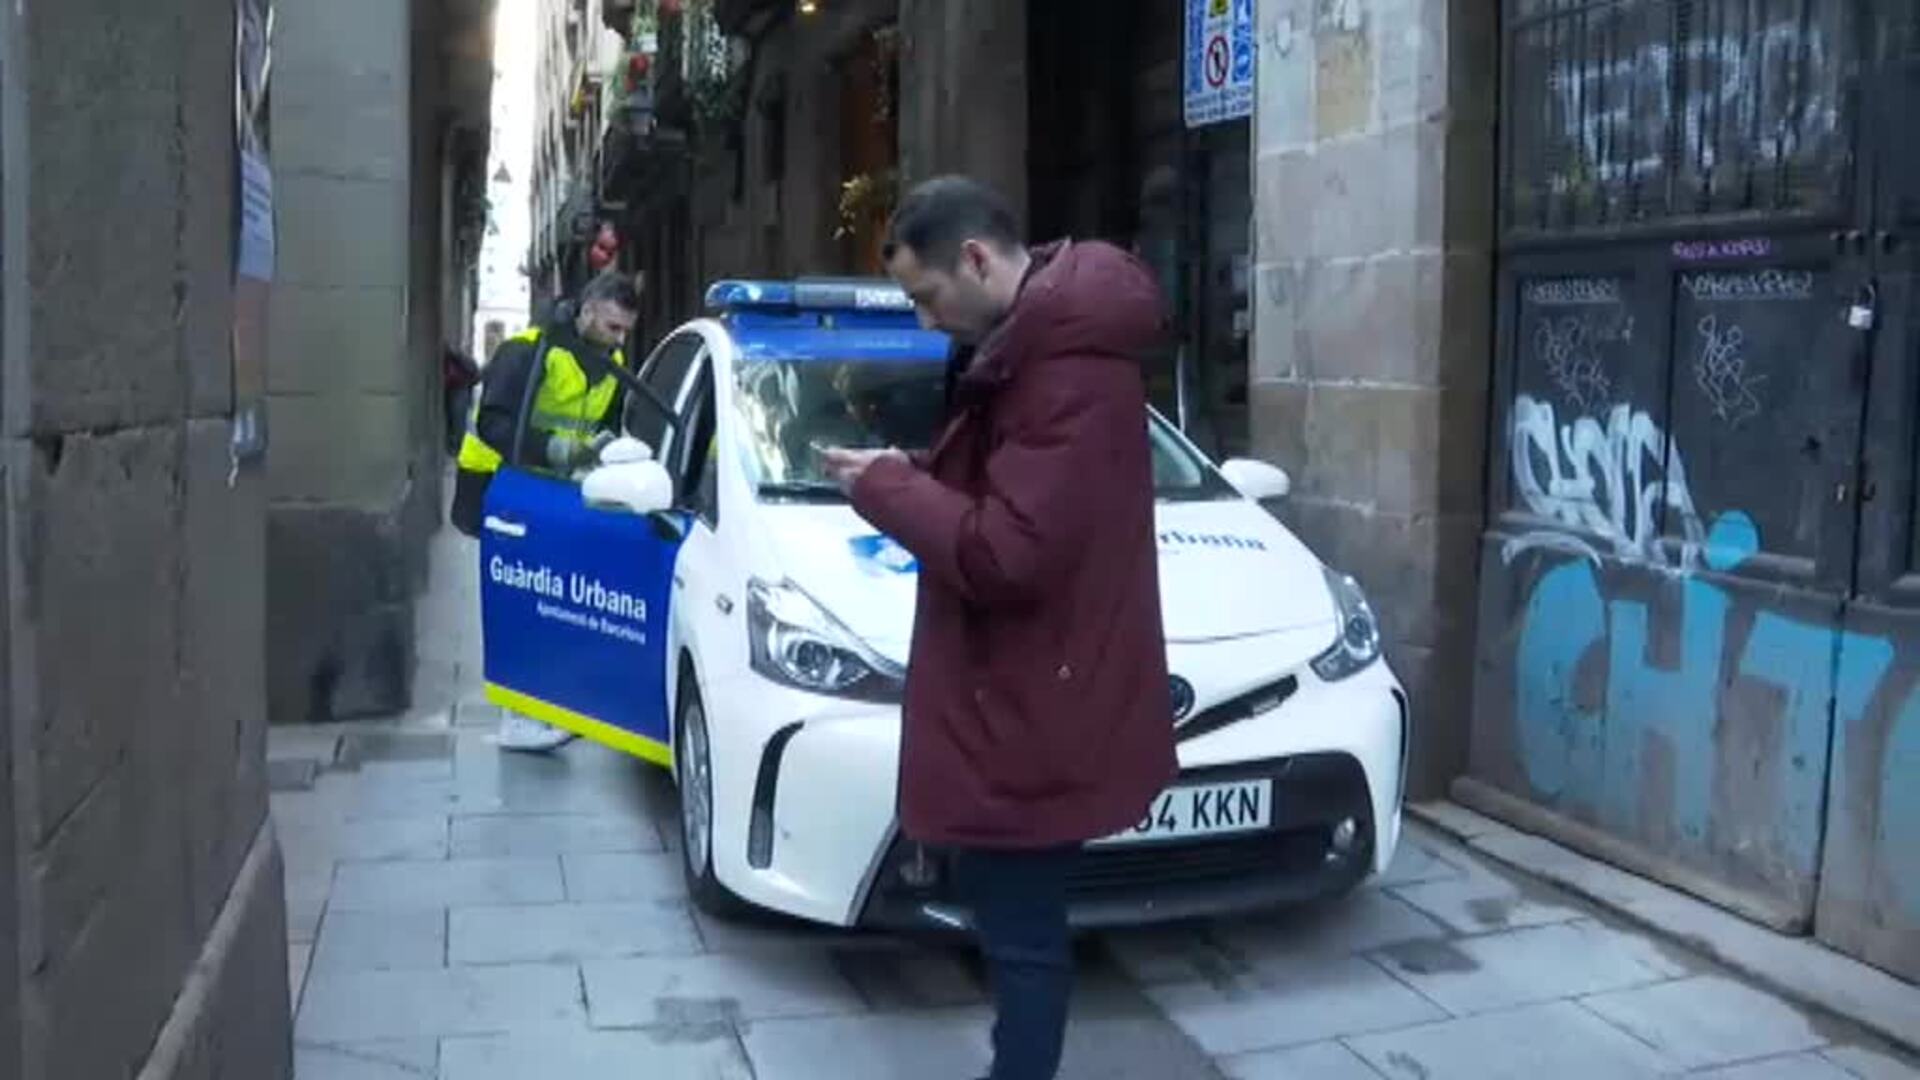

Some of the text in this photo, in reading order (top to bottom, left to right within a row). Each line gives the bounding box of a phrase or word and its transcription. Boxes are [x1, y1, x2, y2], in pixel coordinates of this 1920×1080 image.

[1159, 529, 1268, 552] rbana
[490, 555, 646, 622] Guàrdia Urbana
[1191, 785, 1261, 829] KKN
